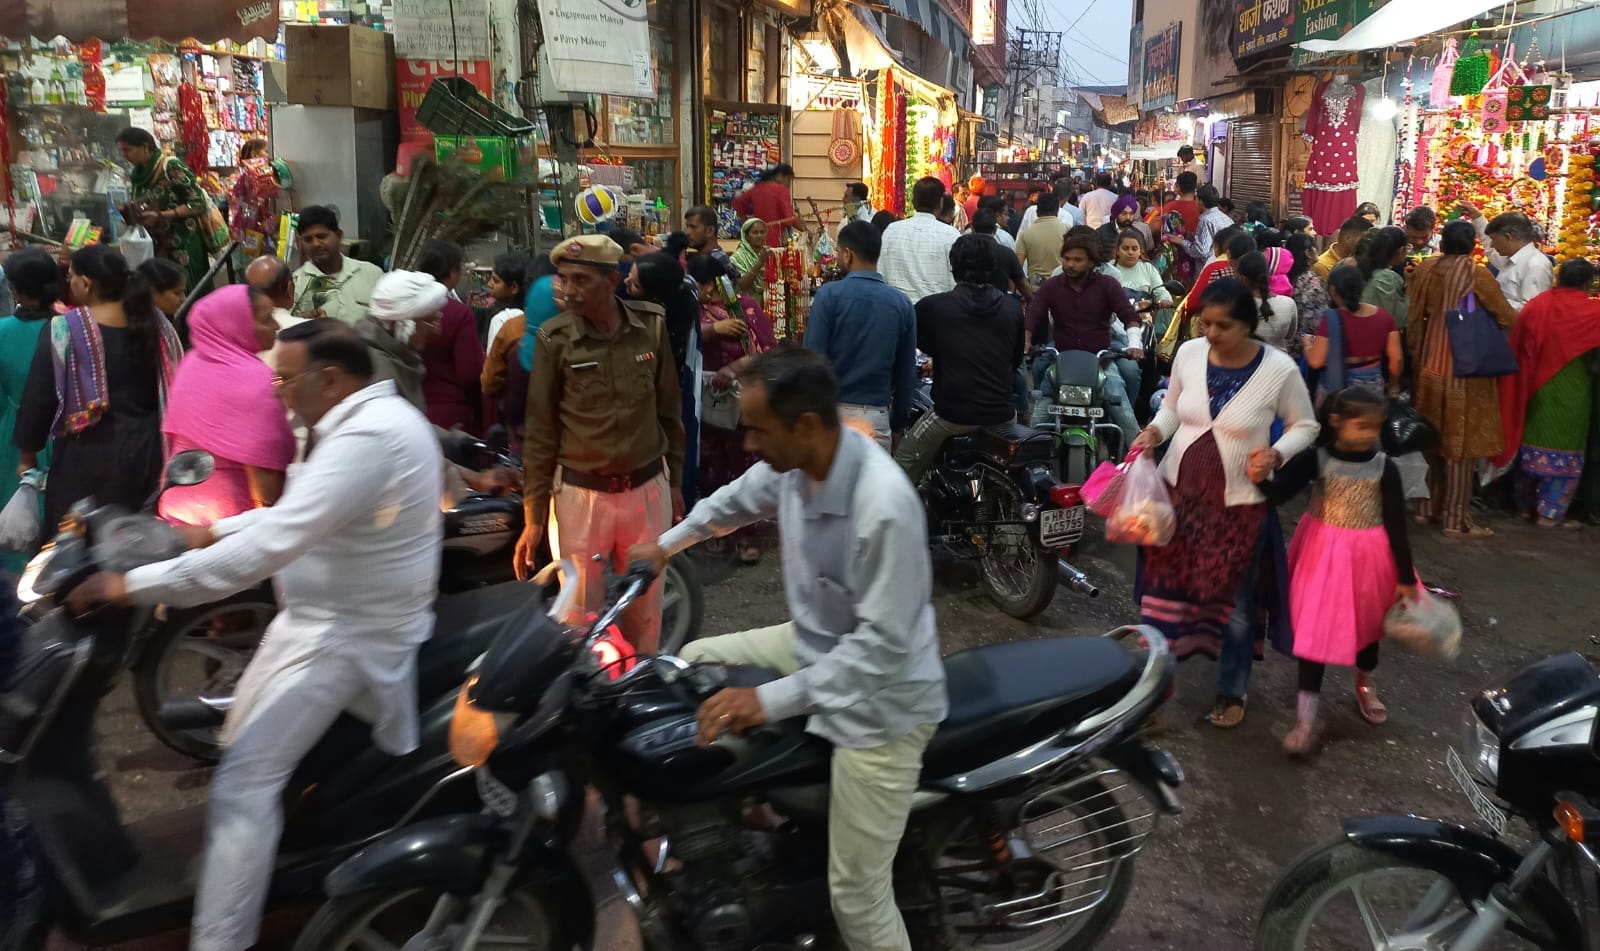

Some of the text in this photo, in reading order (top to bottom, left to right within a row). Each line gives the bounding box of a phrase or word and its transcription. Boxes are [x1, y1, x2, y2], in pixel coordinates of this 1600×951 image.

[555, 8, 624, 25] Engagement Makeup
[1305, 11, 1338, 36] Fashion
[560, 34, 607, 48] Party Makeup
[1053, 509, 1077, 522] HR 07
